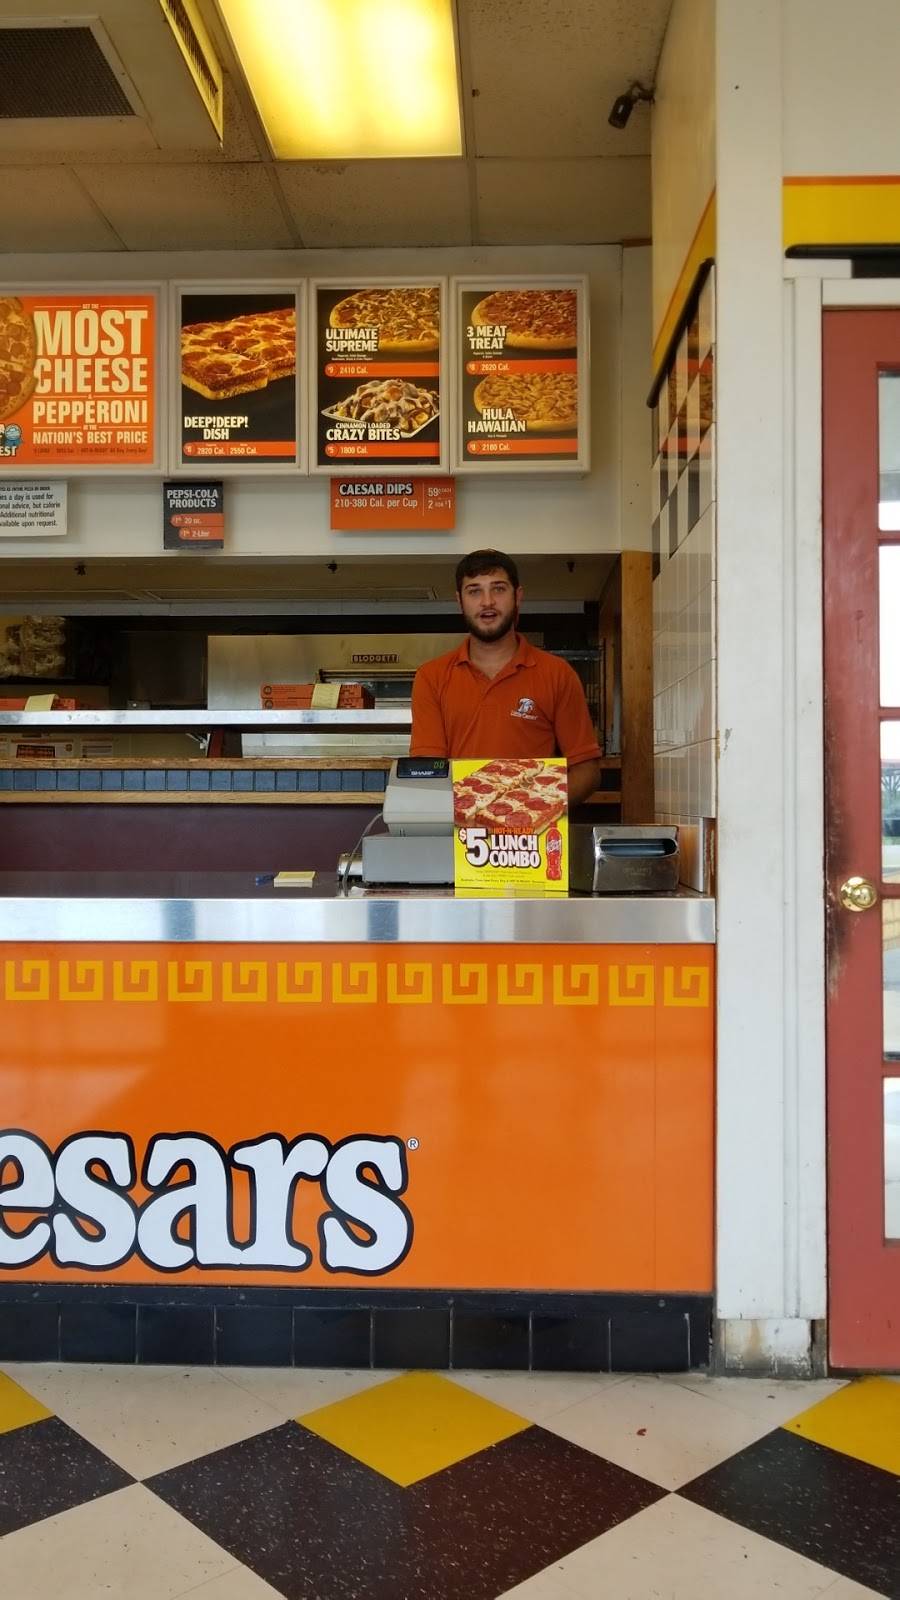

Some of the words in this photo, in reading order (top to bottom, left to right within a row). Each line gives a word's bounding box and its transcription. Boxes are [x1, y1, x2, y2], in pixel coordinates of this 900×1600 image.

[34, 309, 148, 356] MOST
[325, 328, 378, 340] ULTIMATE
[466, 326, 474, 338] 3
[477, 325, 507, 338] MEAT
[325, 340, 378, 352] SUPREME
[469, 337, 505, 350] TREAT
[34, 357, 148, 394] CHEESE
[356, 366, 368, 374] Cal.
[33, 400, 148, 424] PEPPERONI
[482, 408, 514, 421] HULA
[336, 422, 367, 430] CINNAMON
[368, 422, 391, 430] LOADED
[468, 420, 526, 433] HAWAIIAN
[33, 431, 83, 444] NATION'S
[87, 431, 113, 444] BEST
[117, 431, 148, 444] PRICE
[203, 428, 230, 441] DISH
[326, 428, 364, 442] CRAZY
[368, 428, 401, 442] BITES
[166, 488, 219, 500] PEPSI-COLA
[339, 483, 384, 495] CAESAR
[386, 483, 413, 495] DIPS
[14, 494, 24, 502] day
[46, 492, 54, 500] for
[369, 498, 385, 507] Cal.
[386, 499, 400, 509] per
[402, 497, 418, 508] Cup
[12, 502, 31, 510] advice,
[169, 498, 217, 509] PRODUCTS
[428, 500, 434, 509] 2
[28, 509, 55, 517] nutritional
[21, 520, 36, 529] upon
[36, 518, 58, 529] request.
[491, 834, 539, 851] LUNCH
[489, 850, 541, 868] COMBO
